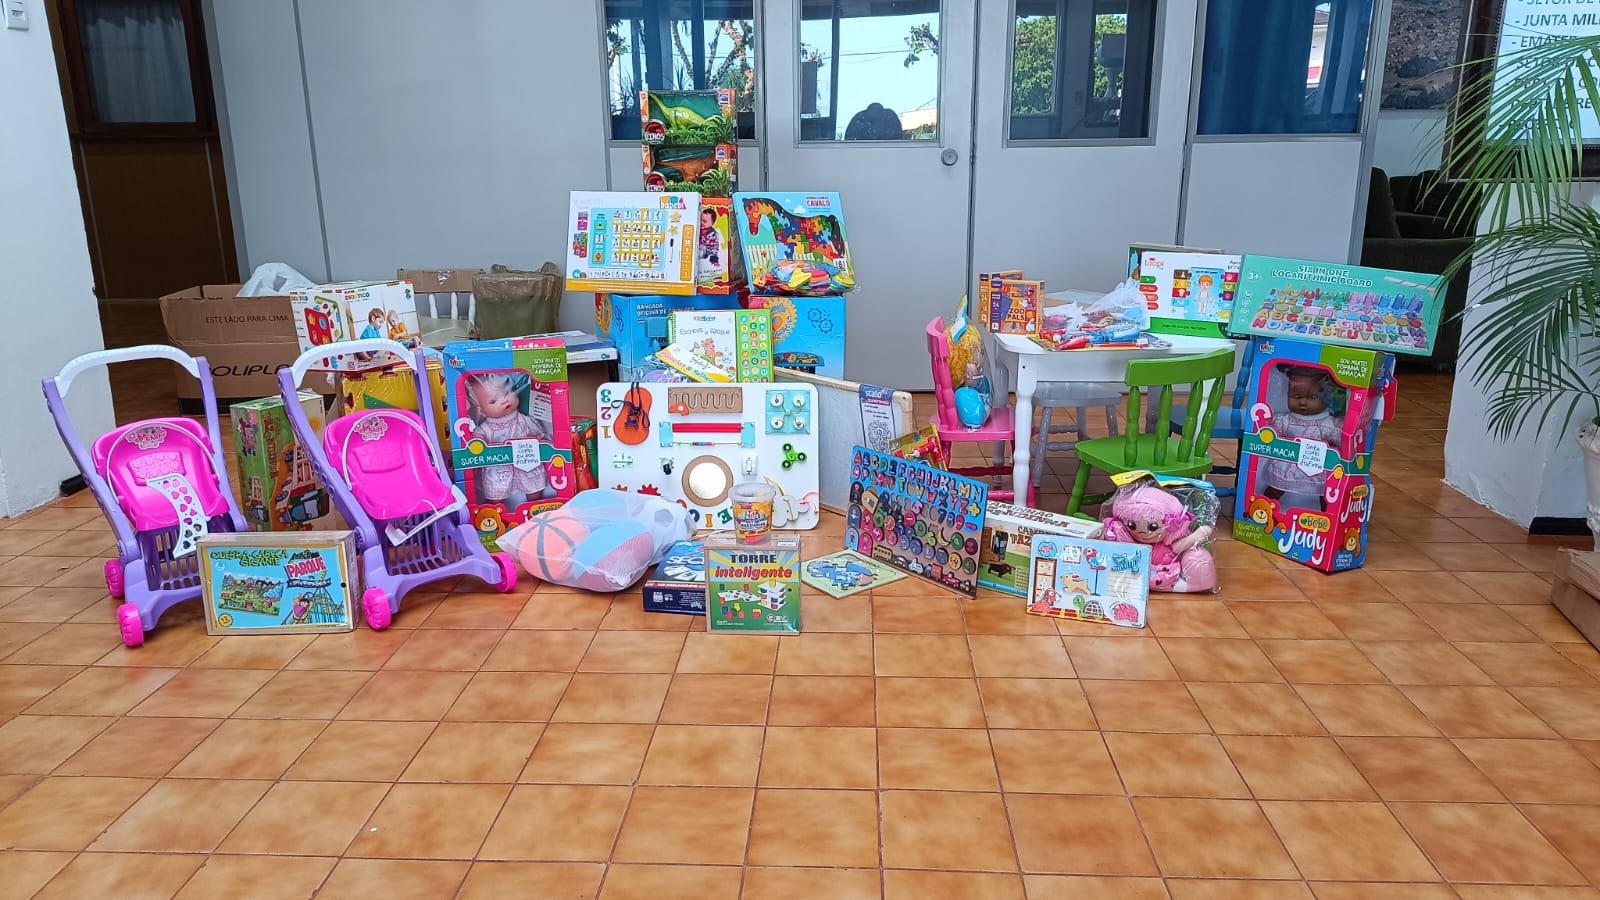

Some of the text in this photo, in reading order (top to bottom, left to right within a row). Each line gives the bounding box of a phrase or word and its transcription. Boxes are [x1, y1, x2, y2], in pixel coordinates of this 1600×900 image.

[1523, 15, 1567, 26] JUNTA
[1247, 271, 1261, 281] 3+
[1298, 264, 1349, 277] SIX IN ONE
[1271, 270, 1373, 288] LOGARITHMIC BOARD
[205, 316, 223, 324] ESTE
[225, 315, 245, 323] LADO
[268, 314, 289, 322] CIMA
[1336, 363, 1359, 372] FOFINHA
[1351, 359, 1368, 367] MUITO
[209, 363, 290, 377] OLIPL
[1338, 369, 1366, 379] ABRAÇAR
[1249, 442, 1296, 459] SUPER MACIA
[461, 453, 510, 466] SUPER MACIA
[1340, 490, 1367, 523] judy
[1278, 514, 1327, 565] judy
[239, 557, 281, 567] GIGANTE
[729, 554, 777, 564] TORRE
[286, 557, 327, 578] PARQUE
[714, 565, 793, 580] inteligente
